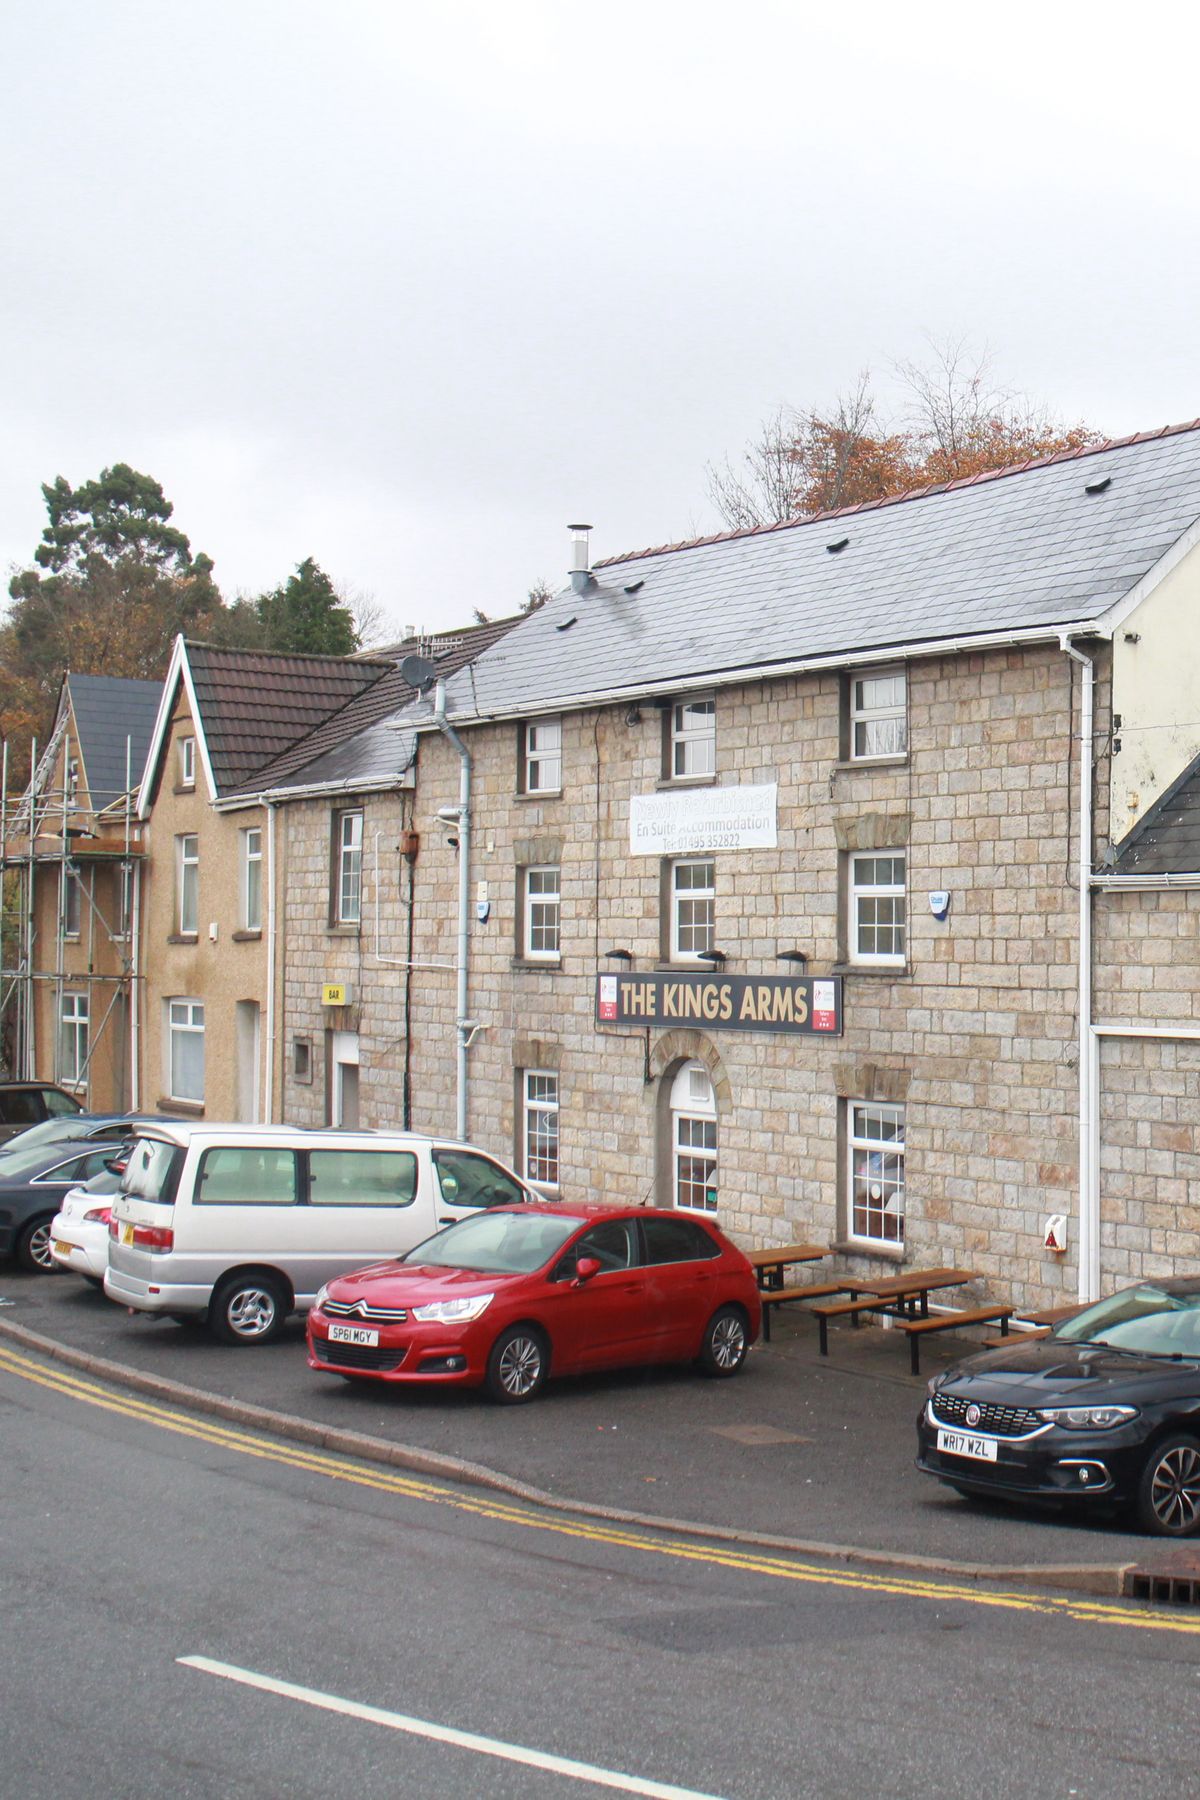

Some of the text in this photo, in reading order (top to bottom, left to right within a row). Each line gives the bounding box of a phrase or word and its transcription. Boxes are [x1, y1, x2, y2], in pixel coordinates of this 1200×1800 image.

[637, 814, 770, 837] En Suite Accommodation
[707, 833, 740, 848] 352822
[328, 989, 340, 1000] BAR
[620, 982, 808, 1024] THE KINGS ARMS
[333, 1327, 372, 1343] SP61 MGY
[943, 1433, 989, 1457] WR17 WZL
